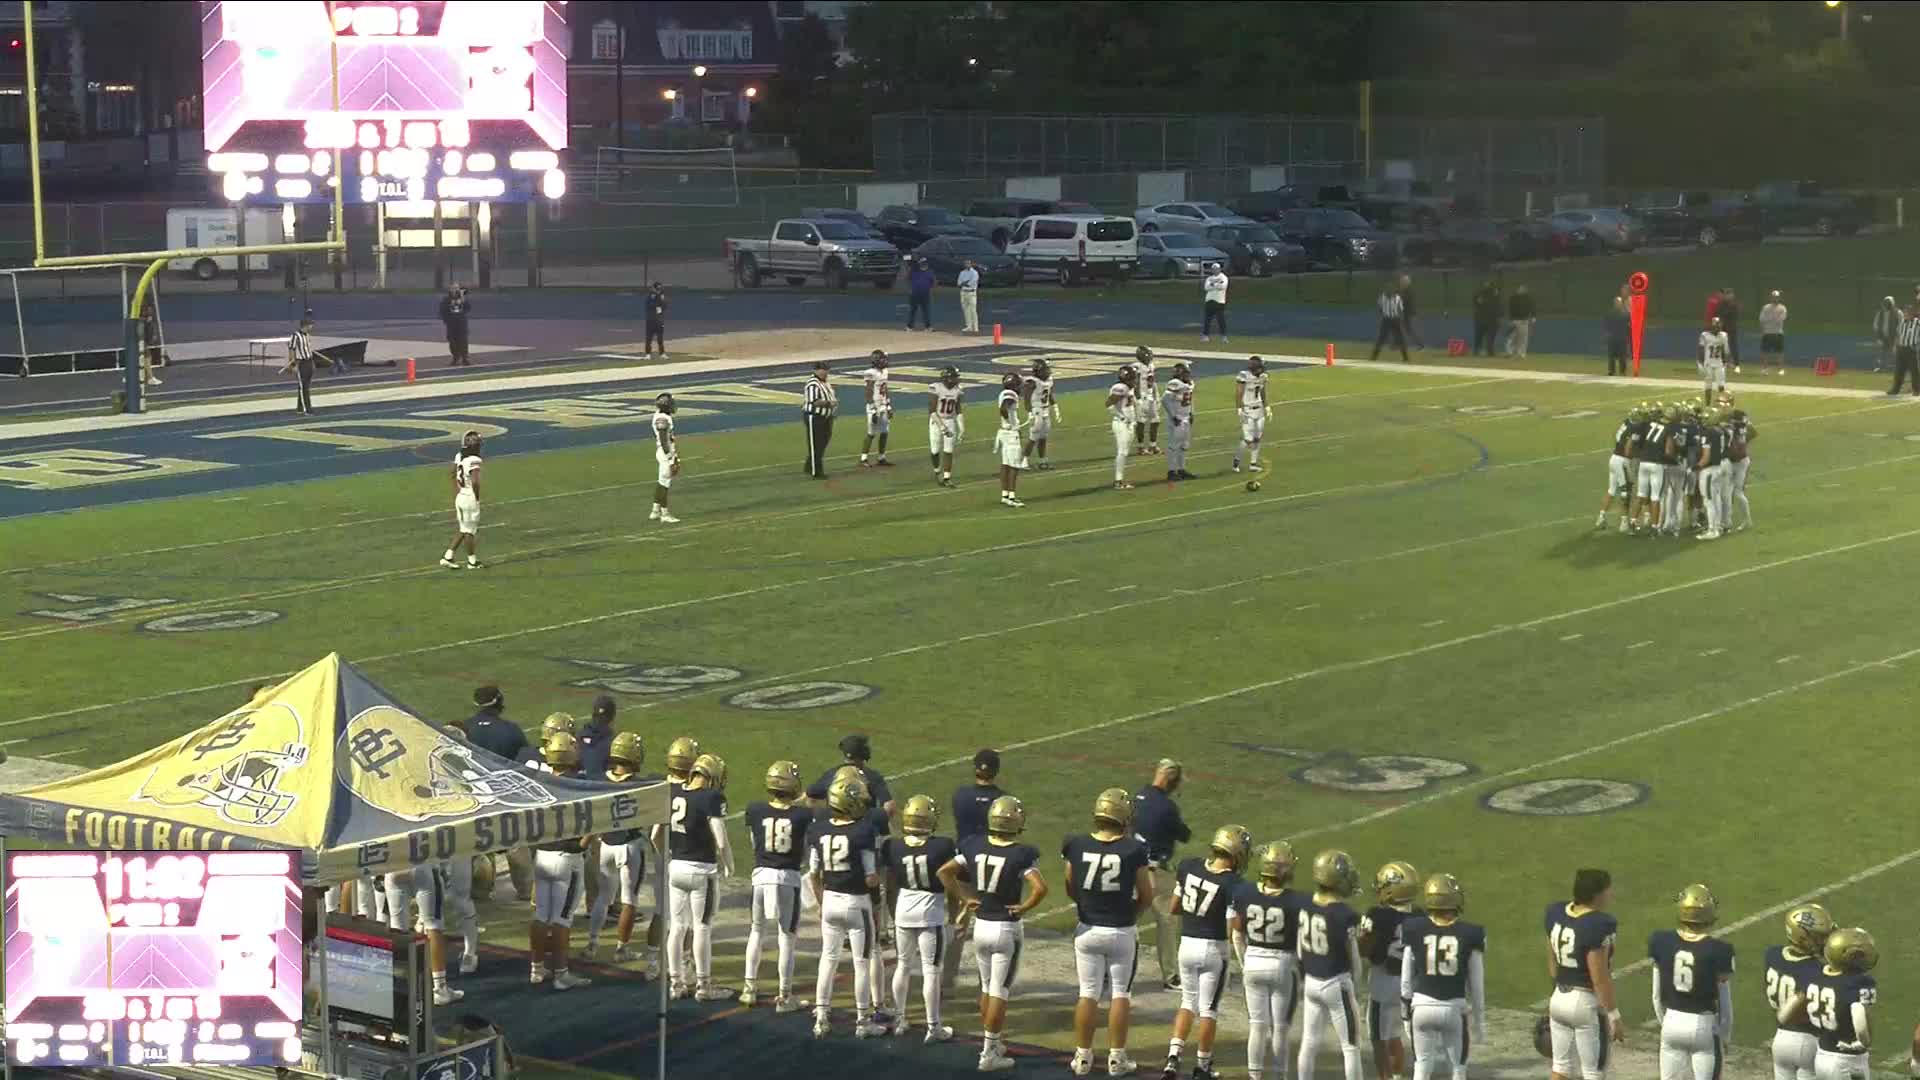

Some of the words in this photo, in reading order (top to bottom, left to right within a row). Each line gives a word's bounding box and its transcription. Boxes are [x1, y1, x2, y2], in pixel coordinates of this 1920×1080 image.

[940, 398, 956, 418] 10
[1646, 421, 1665, 443] 77
[408, 824, 456, 864] GO
[474, 801, 593, 863] SOUTH
[762, 817, 793, 853] 18
[820, 834, 850, 872] 12
[901, 854, 930, 890] 11
[974, 853, 1006, 893] 17
[1081, 851, 1121, 892] 72
[1181, 873, 1220, 917] 57
[1246, 903, 1285, 943] 22
[1298, 909, 1329, 956] 26
[1422, 934, 1460, 976] 13
[1673, 949, 1694, 993] 6
[1765, 968, 1797, 1010] 20
[1806, 982, 1838, 1030] 23
